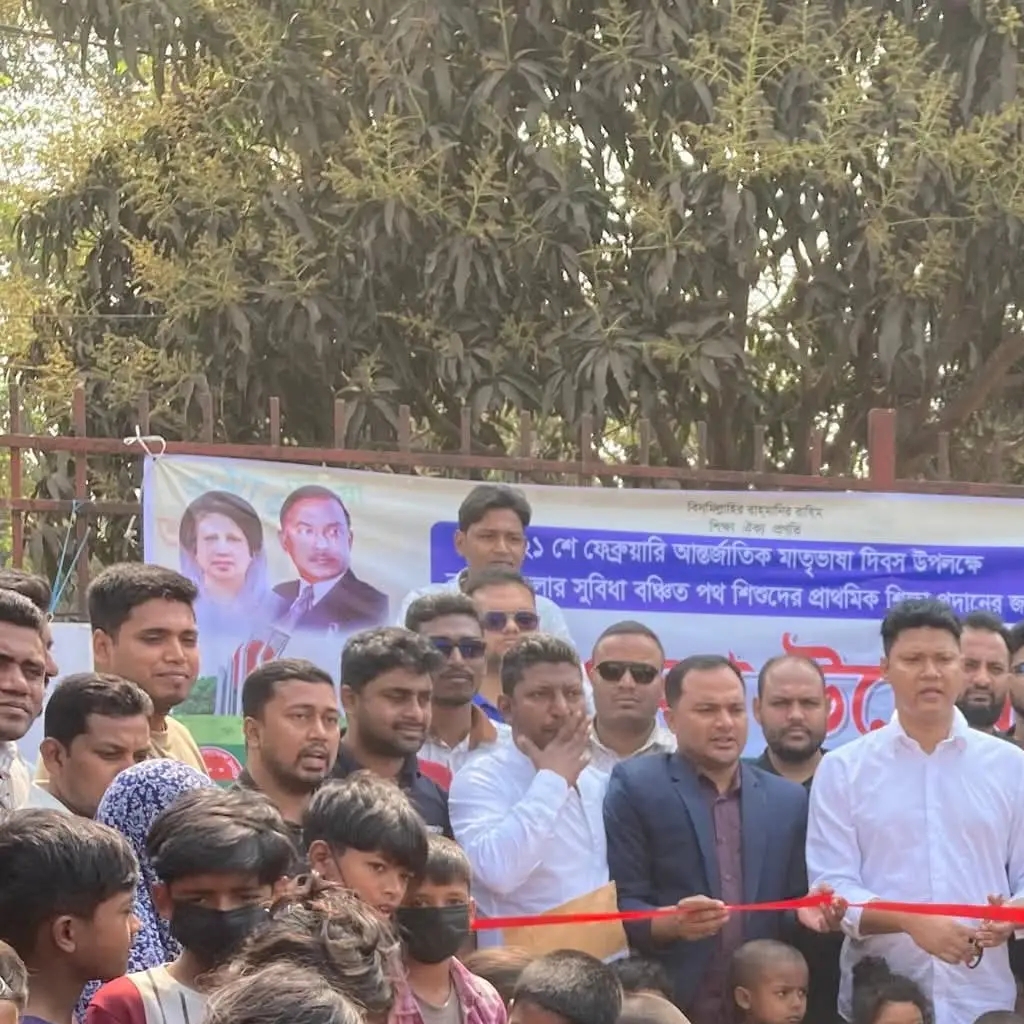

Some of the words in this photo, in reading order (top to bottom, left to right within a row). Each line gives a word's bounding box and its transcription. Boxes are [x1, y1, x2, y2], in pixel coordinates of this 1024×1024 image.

[552, 537, 578, 559] শে
[583, 535, 668, 564] ফেব্রুয়ারি
[671, 539, 773, 567] আন্তর্জাতিক
[775, 547, 854, 578] মাতৃভাষা
[859, 545, 907, 574] দিবস
[911, 548, 985, 576] উপলক্ষে
[570, 572, 628, 605] সুবিধা
[633, 573, 691, 604] বঞ্চিত
[696, 580, 727, 605] পথ
[731, 578, 804, 608] শিশুদের
[808, 582, 881, 611] প্রাথমিক
